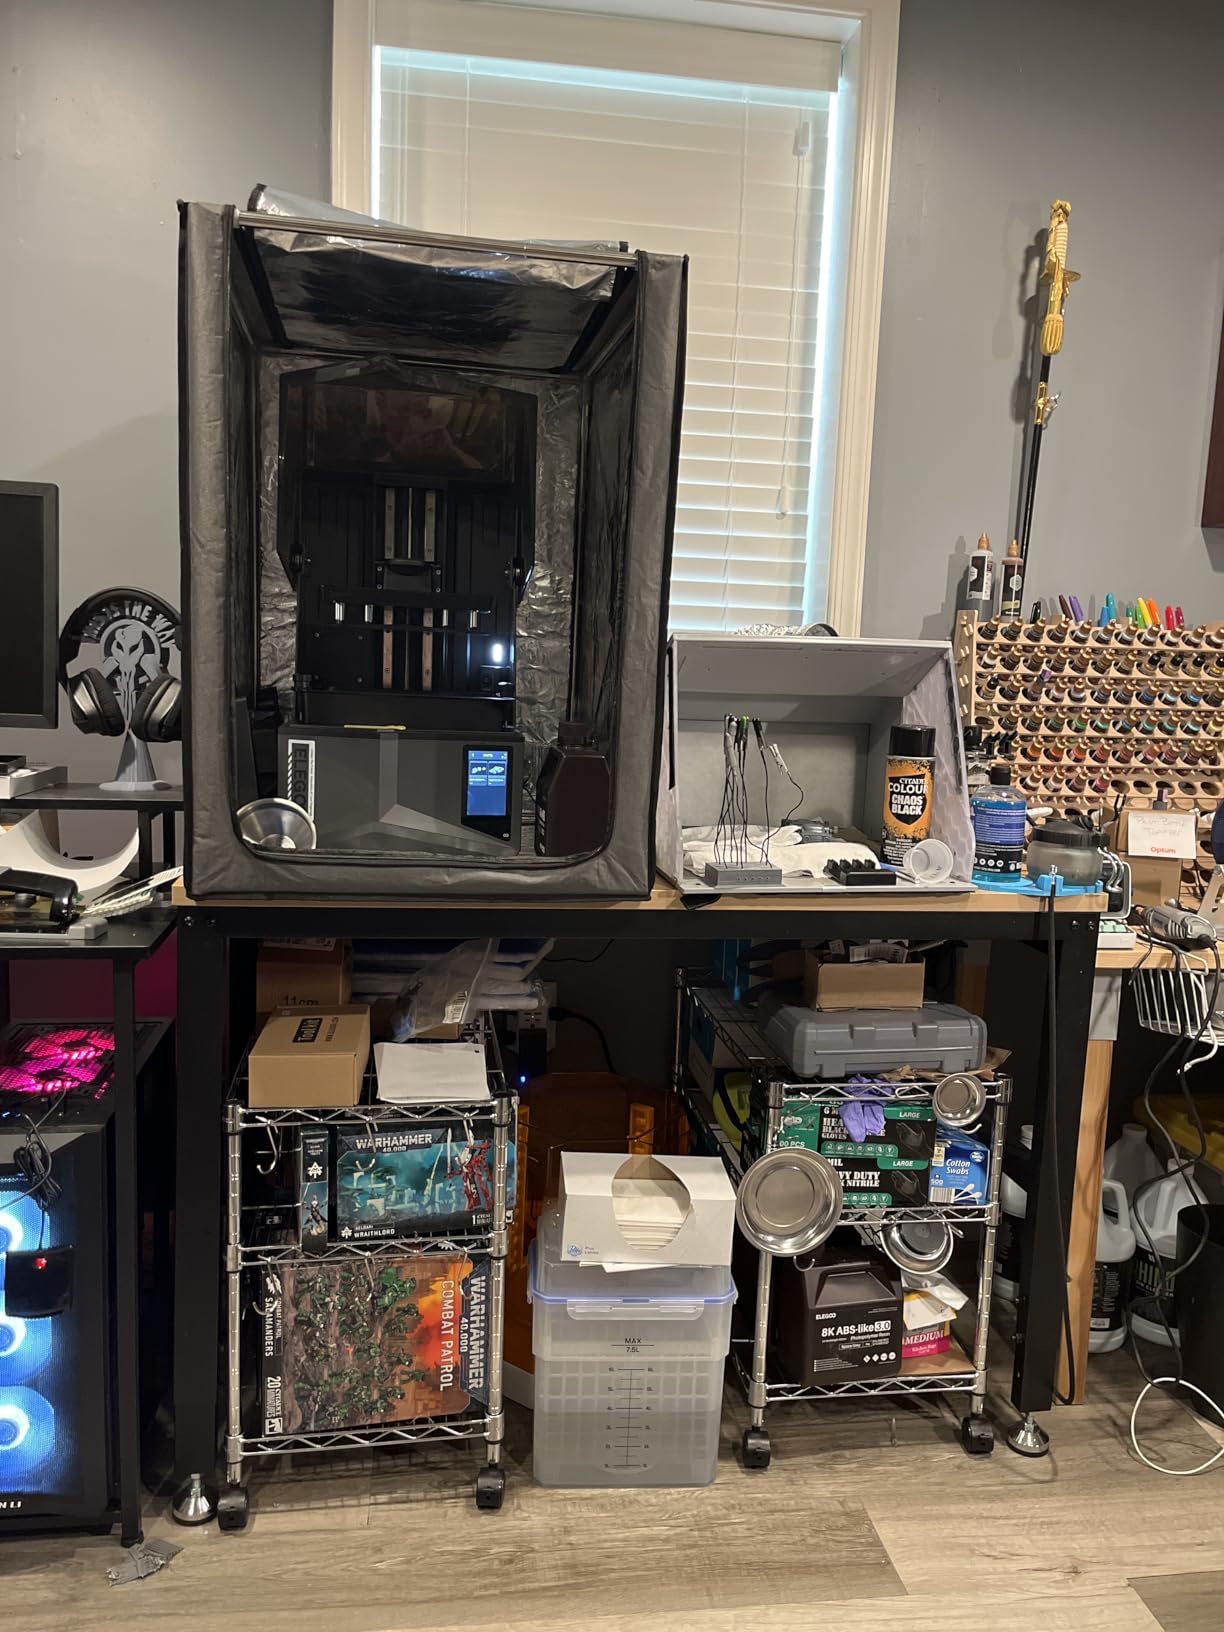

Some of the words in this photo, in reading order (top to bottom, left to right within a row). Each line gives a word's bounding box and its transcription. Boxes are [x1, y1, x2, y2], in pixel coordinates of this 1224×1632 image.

[124, 600, 153, 622] THE
[151, 613, 176, 648] WAY
[294, 748, 307, 806] ELEGO
[891, 794, 923, 805] CHAOS
[891, 804, 922, 815] BLACK
[1150, 846, 1176, 854] Optum
[823, 1117, 844, 1126] HEA
[356, 1134, 432, 1150] WARHAMMER
[822, 1132, 847, 1140] GLOVES
[946, 1158, 970, 1168] Cotton
[854, 1172, 880, 1180] DUTY
[946, 1166, 969, 1175] Swabs
[847, 1180, 880, 1188] NITRILE
[354, 1228, 396, 1238] WRAITHLORD
[1136, 1260, 1176, 1292] HINO
[441, 1280, 454, 1335] COMBAT
[816, 1312, 836, 1320] ELEGOO
[265, 1297, 274, 1357] SALAMANDERS
[468, 1276, 486, 1390] WARHAMMER
[822, 1327, 836, 1338] 8K
[836, 1323, 874, 1336] ABS-like
[876, 1321, 891, 1332] 3.0
[904, 1330, 944, 1346] MEDIUM
[440, 1340, 454, 1392] PATROL
[268, 1376, 282, 1389] 20
